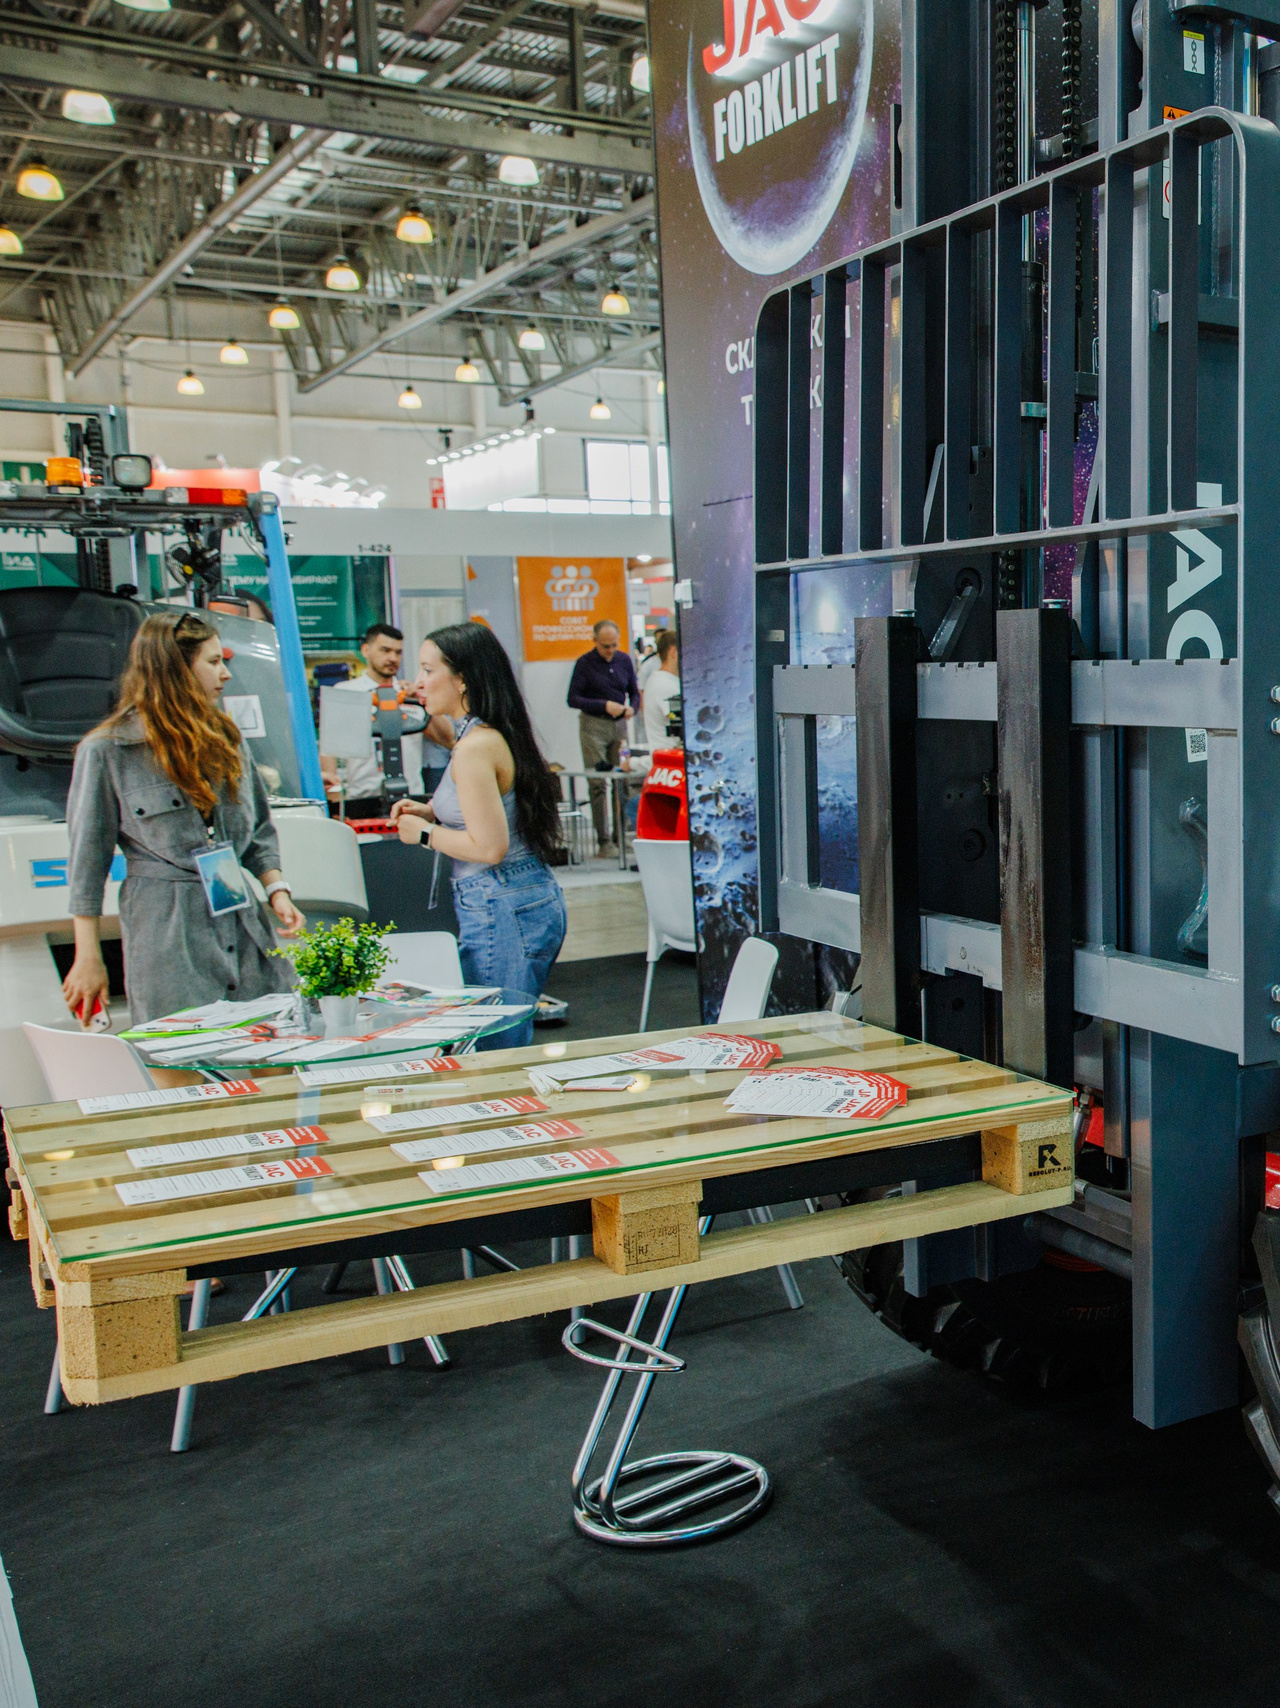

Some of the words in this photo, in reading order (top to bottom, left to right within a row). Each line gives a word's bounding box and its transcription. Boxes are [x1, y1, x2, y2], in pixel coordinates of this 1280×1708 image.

[702, 0, 829, 76] JA
[713, 33, 840, 162] FORKLIFT
[358, 544, 392, 552] 1-424
[1166, 481, 1223, 659] AC
[648, 767, 682, 788] JAC
[618, 1053, 650, 1064] JAC
[483, 1101, 508, 1114] JAC
[837, 1099, 861, 1114] JAC
[261, 1131, 285, 1145] JAC
[499, 1128, 525, 1142] FORKLIFT
[515, 1125, 542, 1139] JAC
[531, 1157, 558, 1172] FORKLIFT
[550, 1155, 577, 1169] JAC
[260, 1163, 286, 1178] JAC
